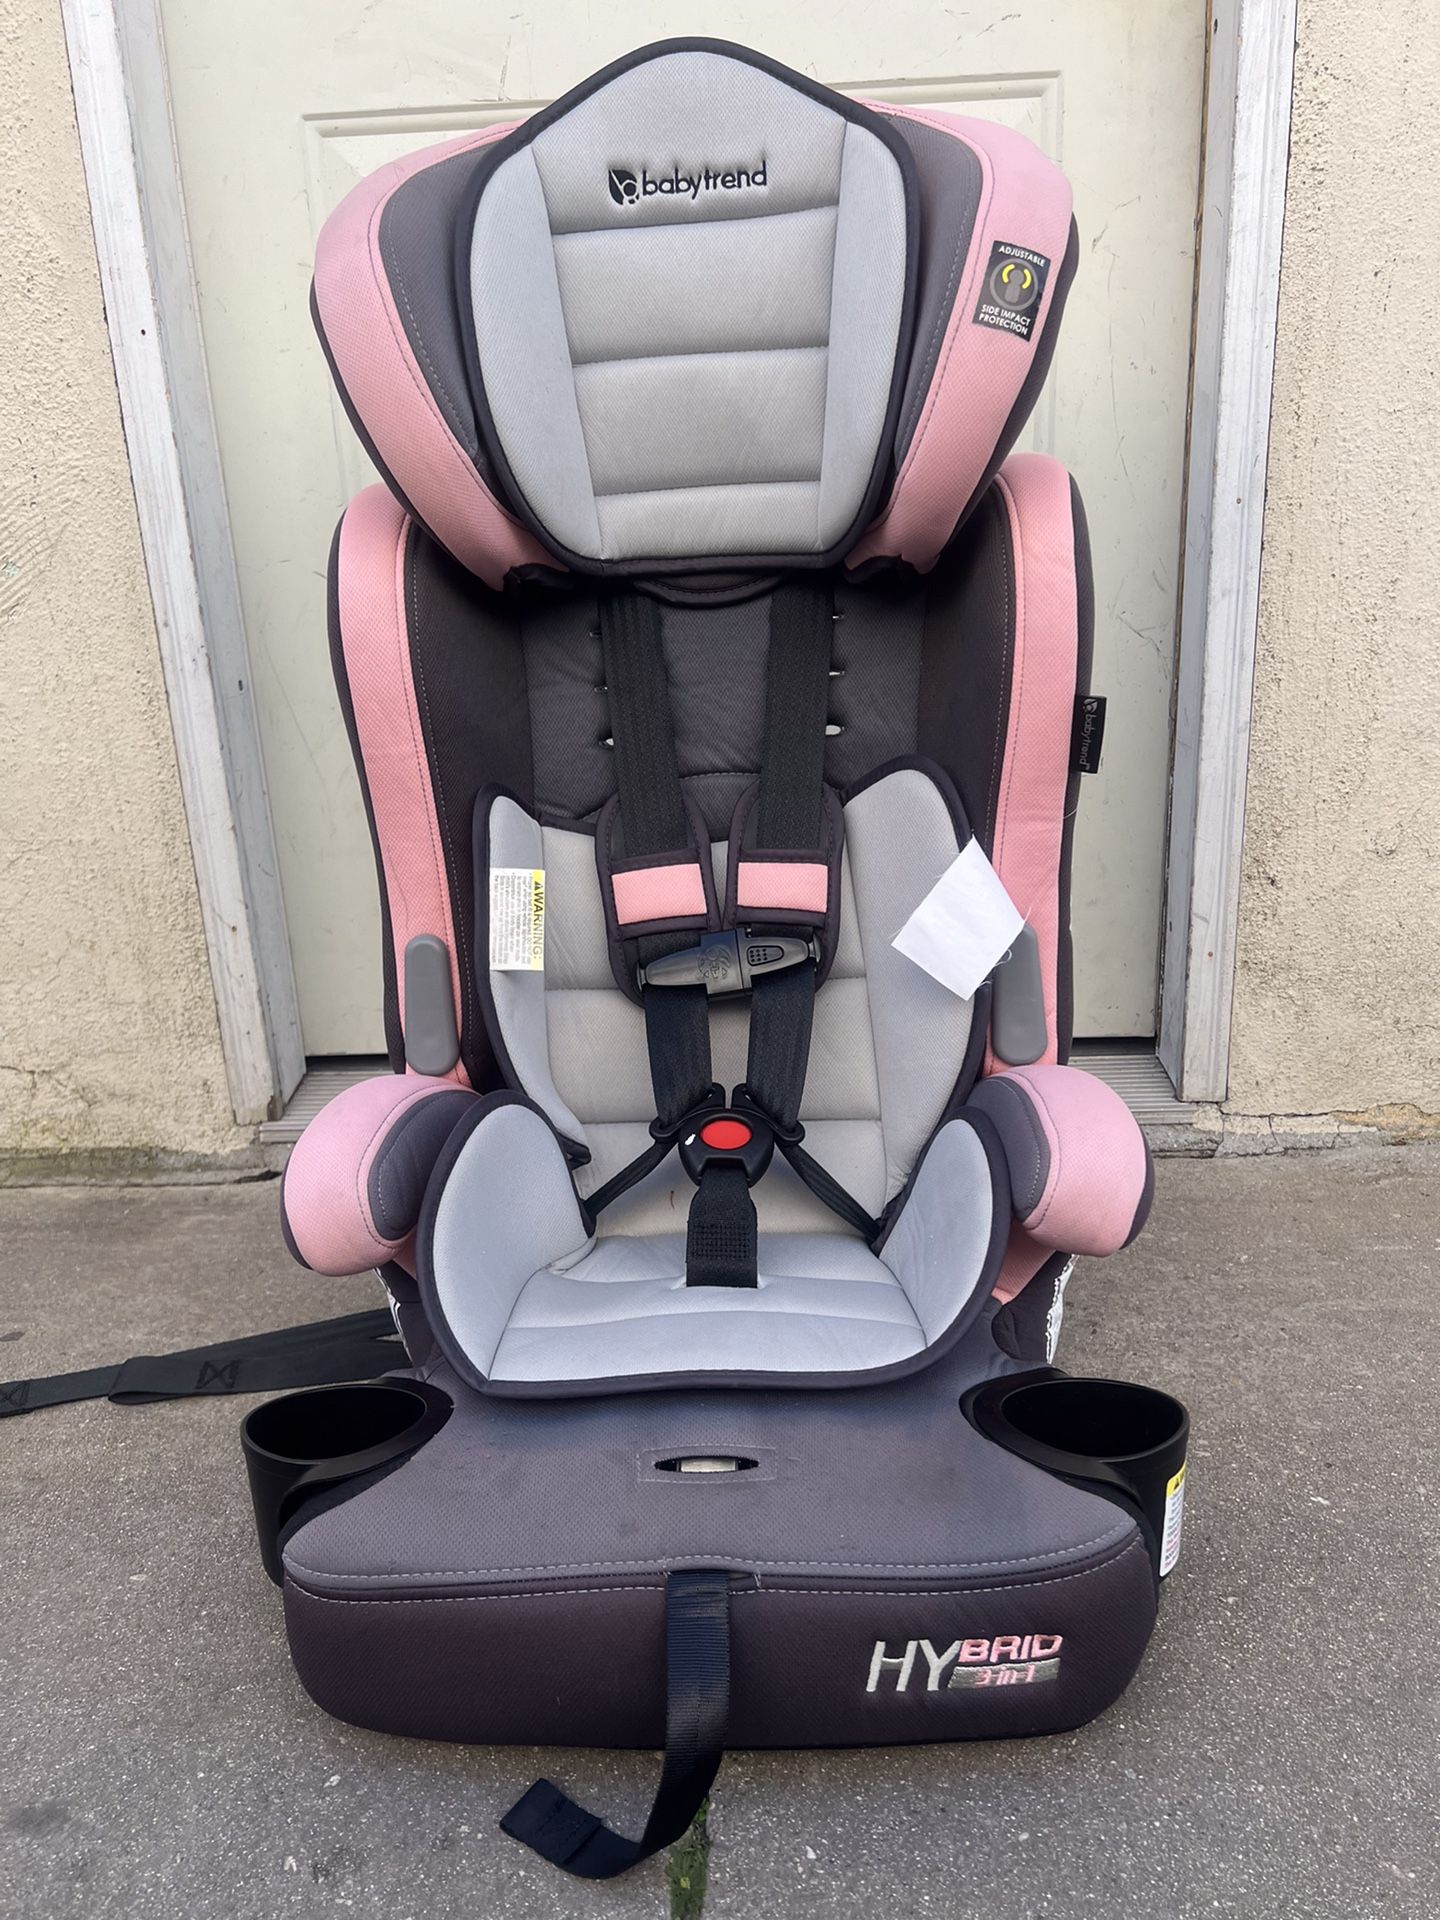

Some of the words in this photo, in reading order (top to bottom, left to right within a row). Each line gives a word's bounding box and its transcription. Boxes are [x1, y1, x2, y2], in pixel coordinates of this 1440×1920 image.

[642, 159, 767, 200] babytrend
[998, 245, 1046, 267] ADJUSTABLE
[978, 313, 1028, 335] PROTECTION
[981, 304, 999, 315] SIDE
[1000, 308, 1031, 326] IMPACT
